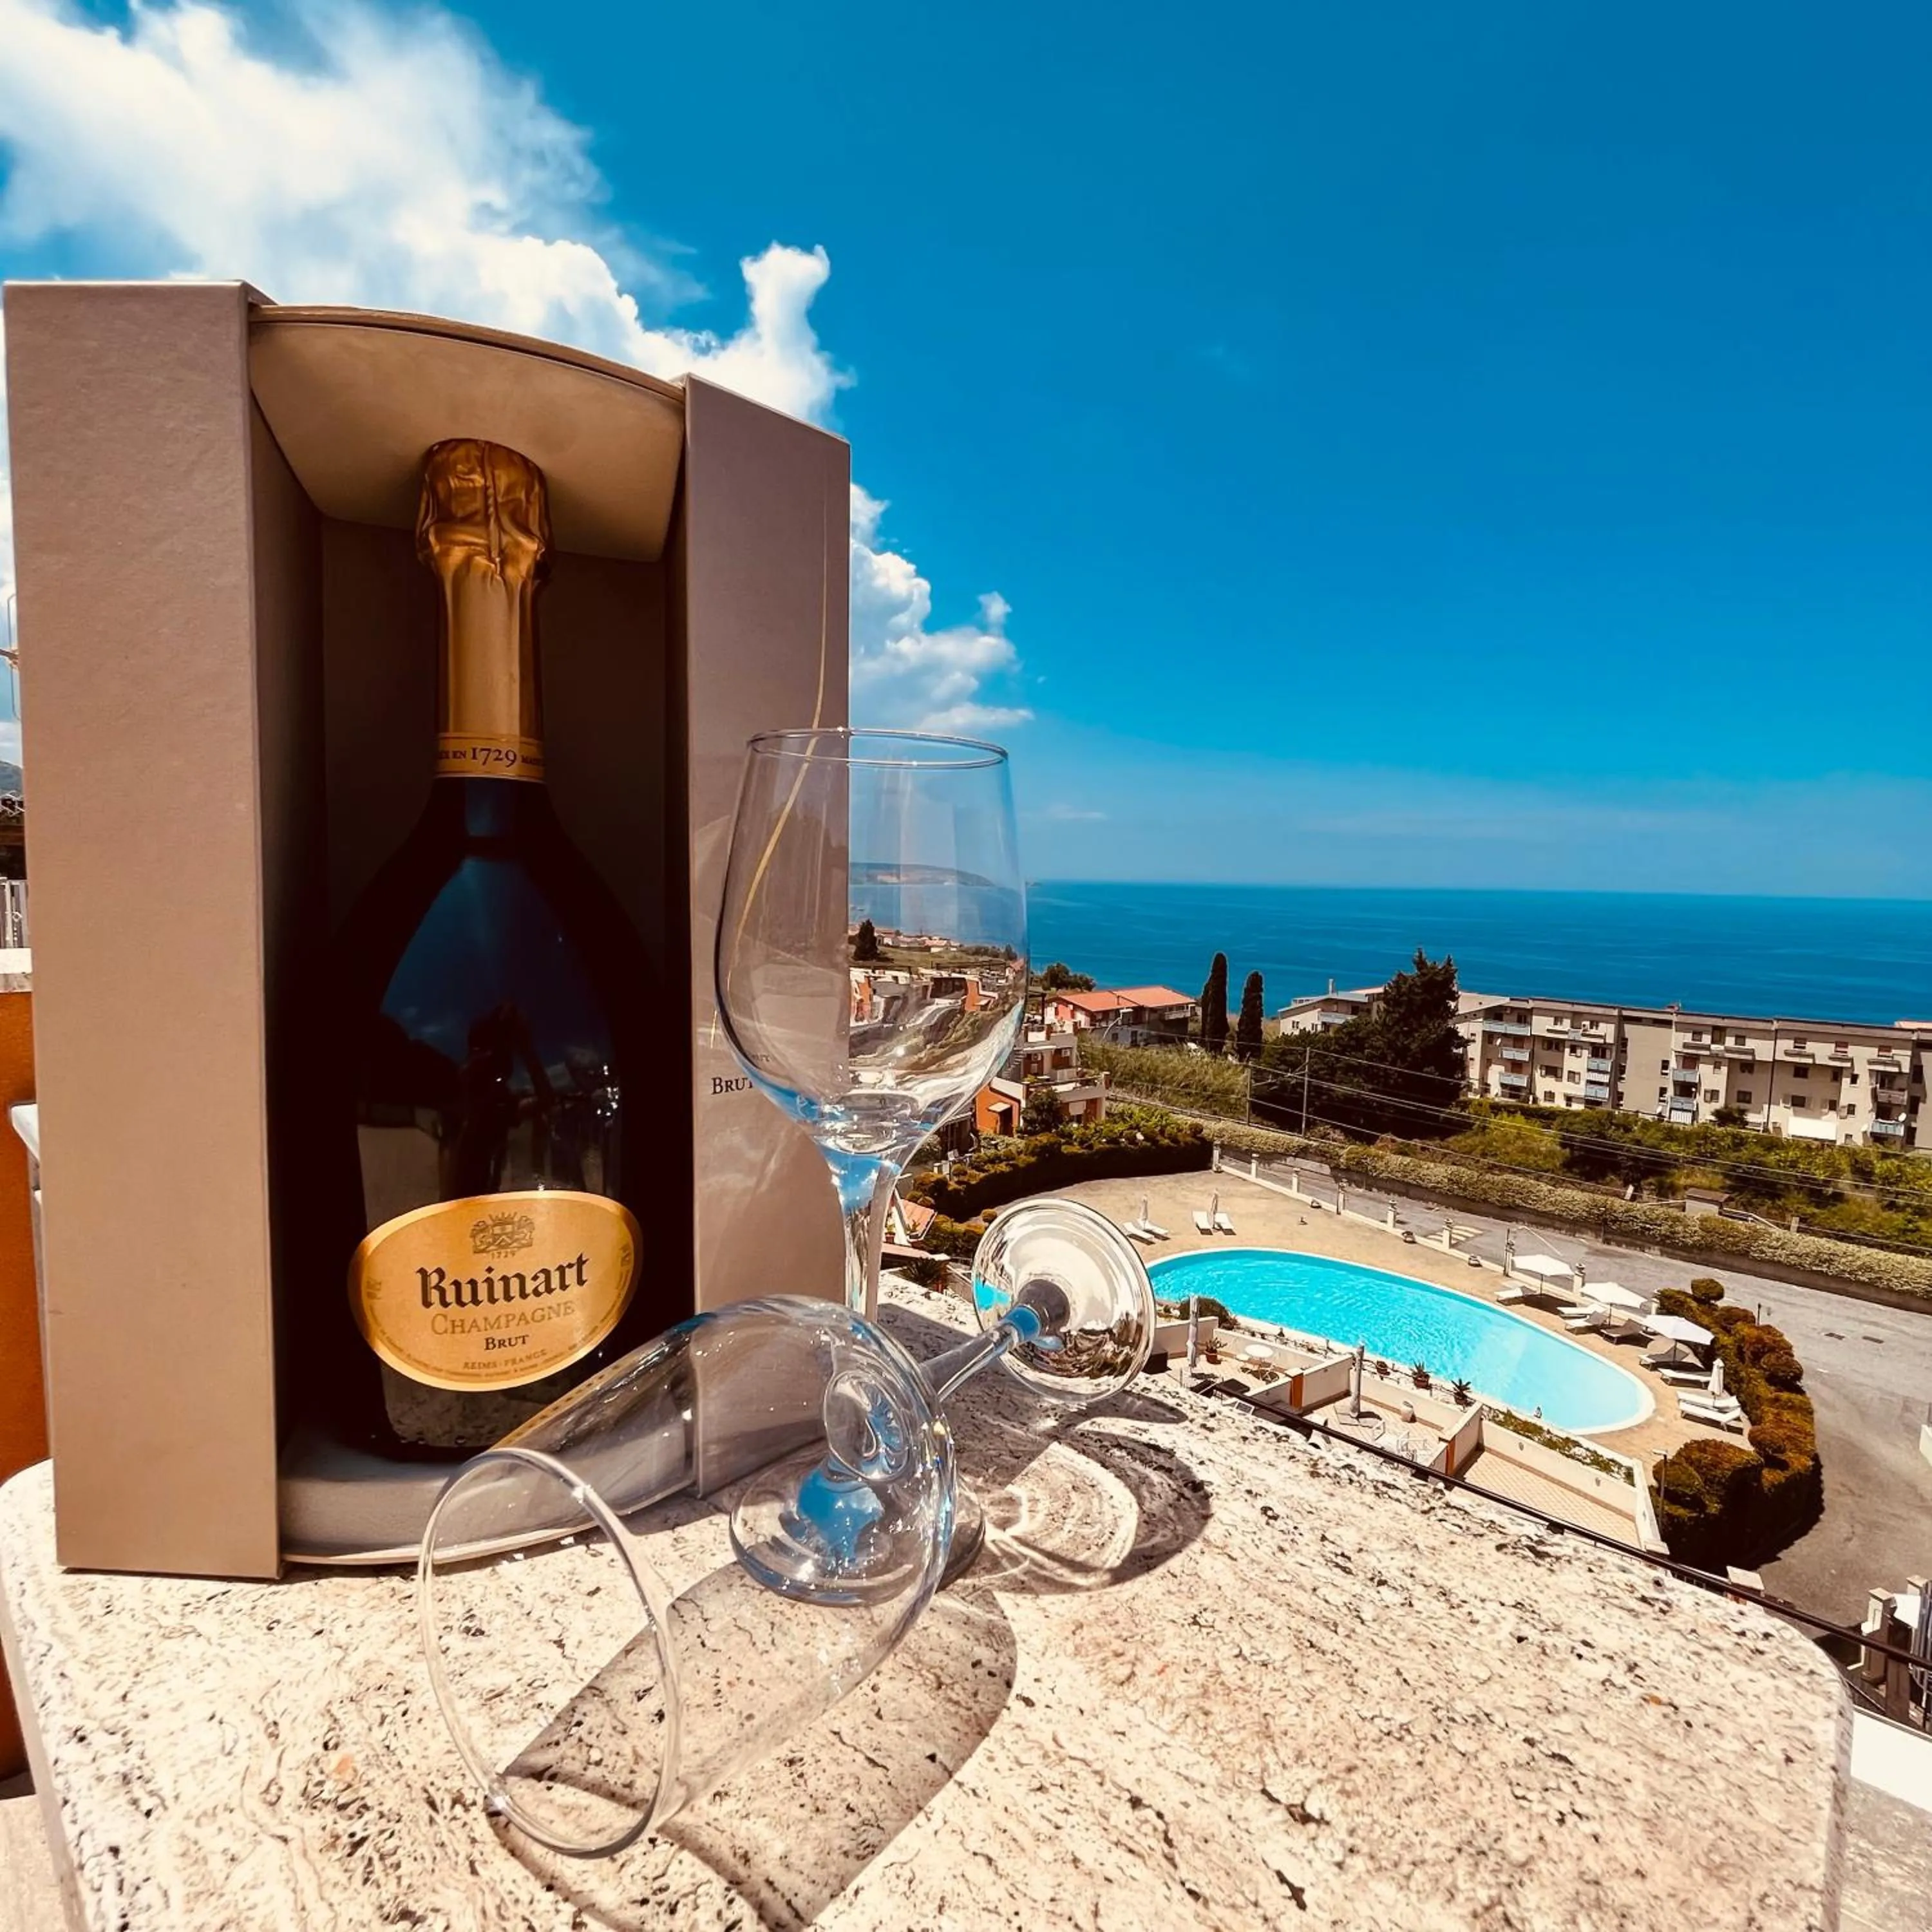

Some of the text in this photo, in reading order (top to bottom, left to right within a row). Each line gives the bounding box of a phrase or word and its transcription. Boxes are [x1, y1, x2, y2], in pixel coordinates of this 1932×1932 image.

[471, 746, 517, 768] 1729
[416, 1253, 590, 1309] Ruinart
[431, 1300, 575, 1335] CHAMPAGNE
[484, 1334, 530, 1351] BRUT
